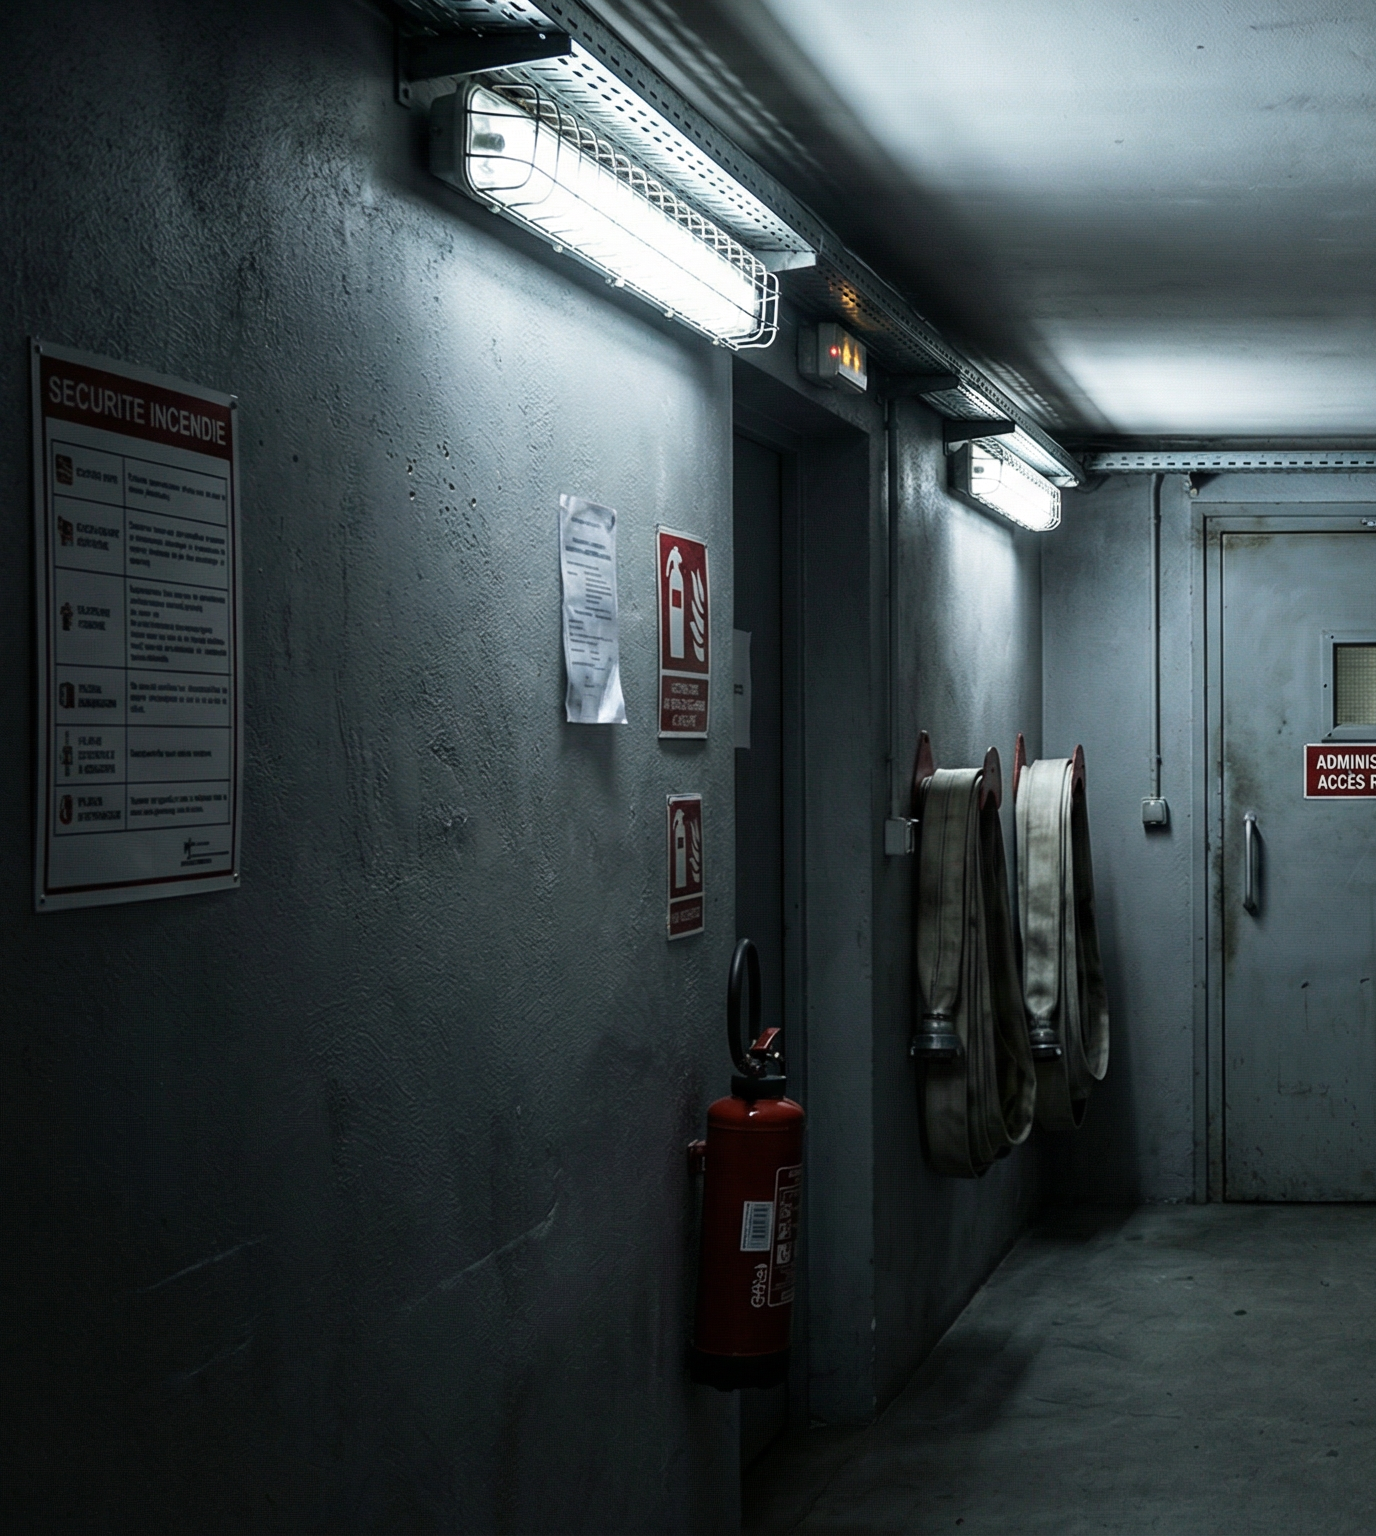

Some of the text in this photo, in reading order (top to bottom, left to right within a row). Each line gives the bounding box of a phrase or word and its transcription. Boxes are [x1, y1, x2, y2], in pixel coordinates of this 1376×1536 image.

[48, 375, 227, 446] SECURITE INCENDIE
[1317, 770, 1366, 790] ACCÈS
